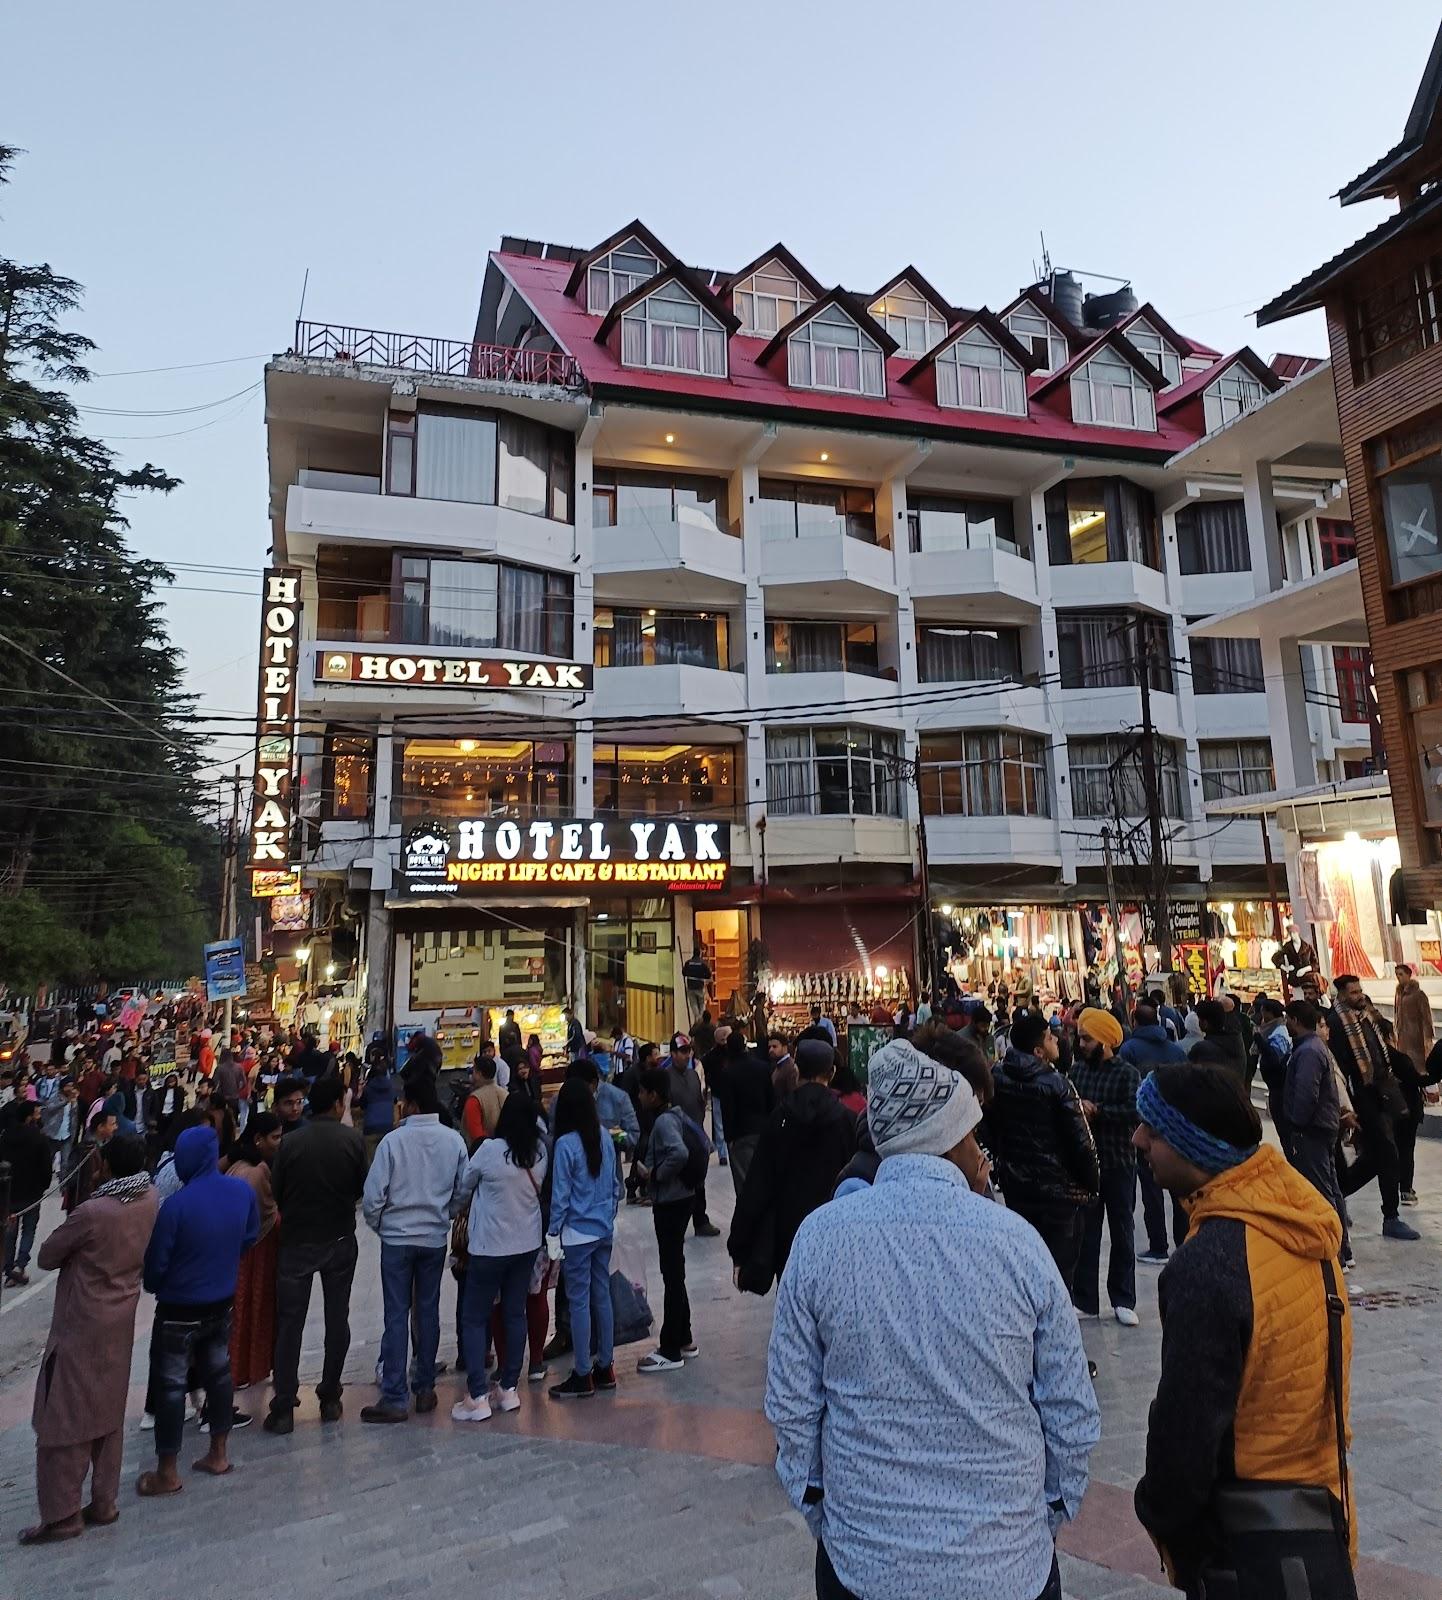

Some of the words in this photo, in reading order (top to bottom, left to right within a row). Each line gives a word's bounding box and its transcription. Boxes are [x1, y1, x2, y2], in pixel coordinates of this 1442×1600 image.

[264, 576, 297, 725] HOTEL
[359, 656, 489, 684] HOTEL
[503, 663, 585, 688] YAK
[253, 768, 289, 860] YAK
[457, 821, 611, 860] HOTEL
[630, 822, 721, 860] YAK
[447, 863, 506, 881] NIGHT
[508, 863, 548, 881] LIFE
[550, 863, 596, 881] CAFE
[598, 863, 613, 881] &
[614, 863, 726, 881] RESTAURANT
[1176, 901, 1199, 914] Ground
[1174, 915, 1200, 929] Complex
[1175, 929, 1200, 940] ITEMS
